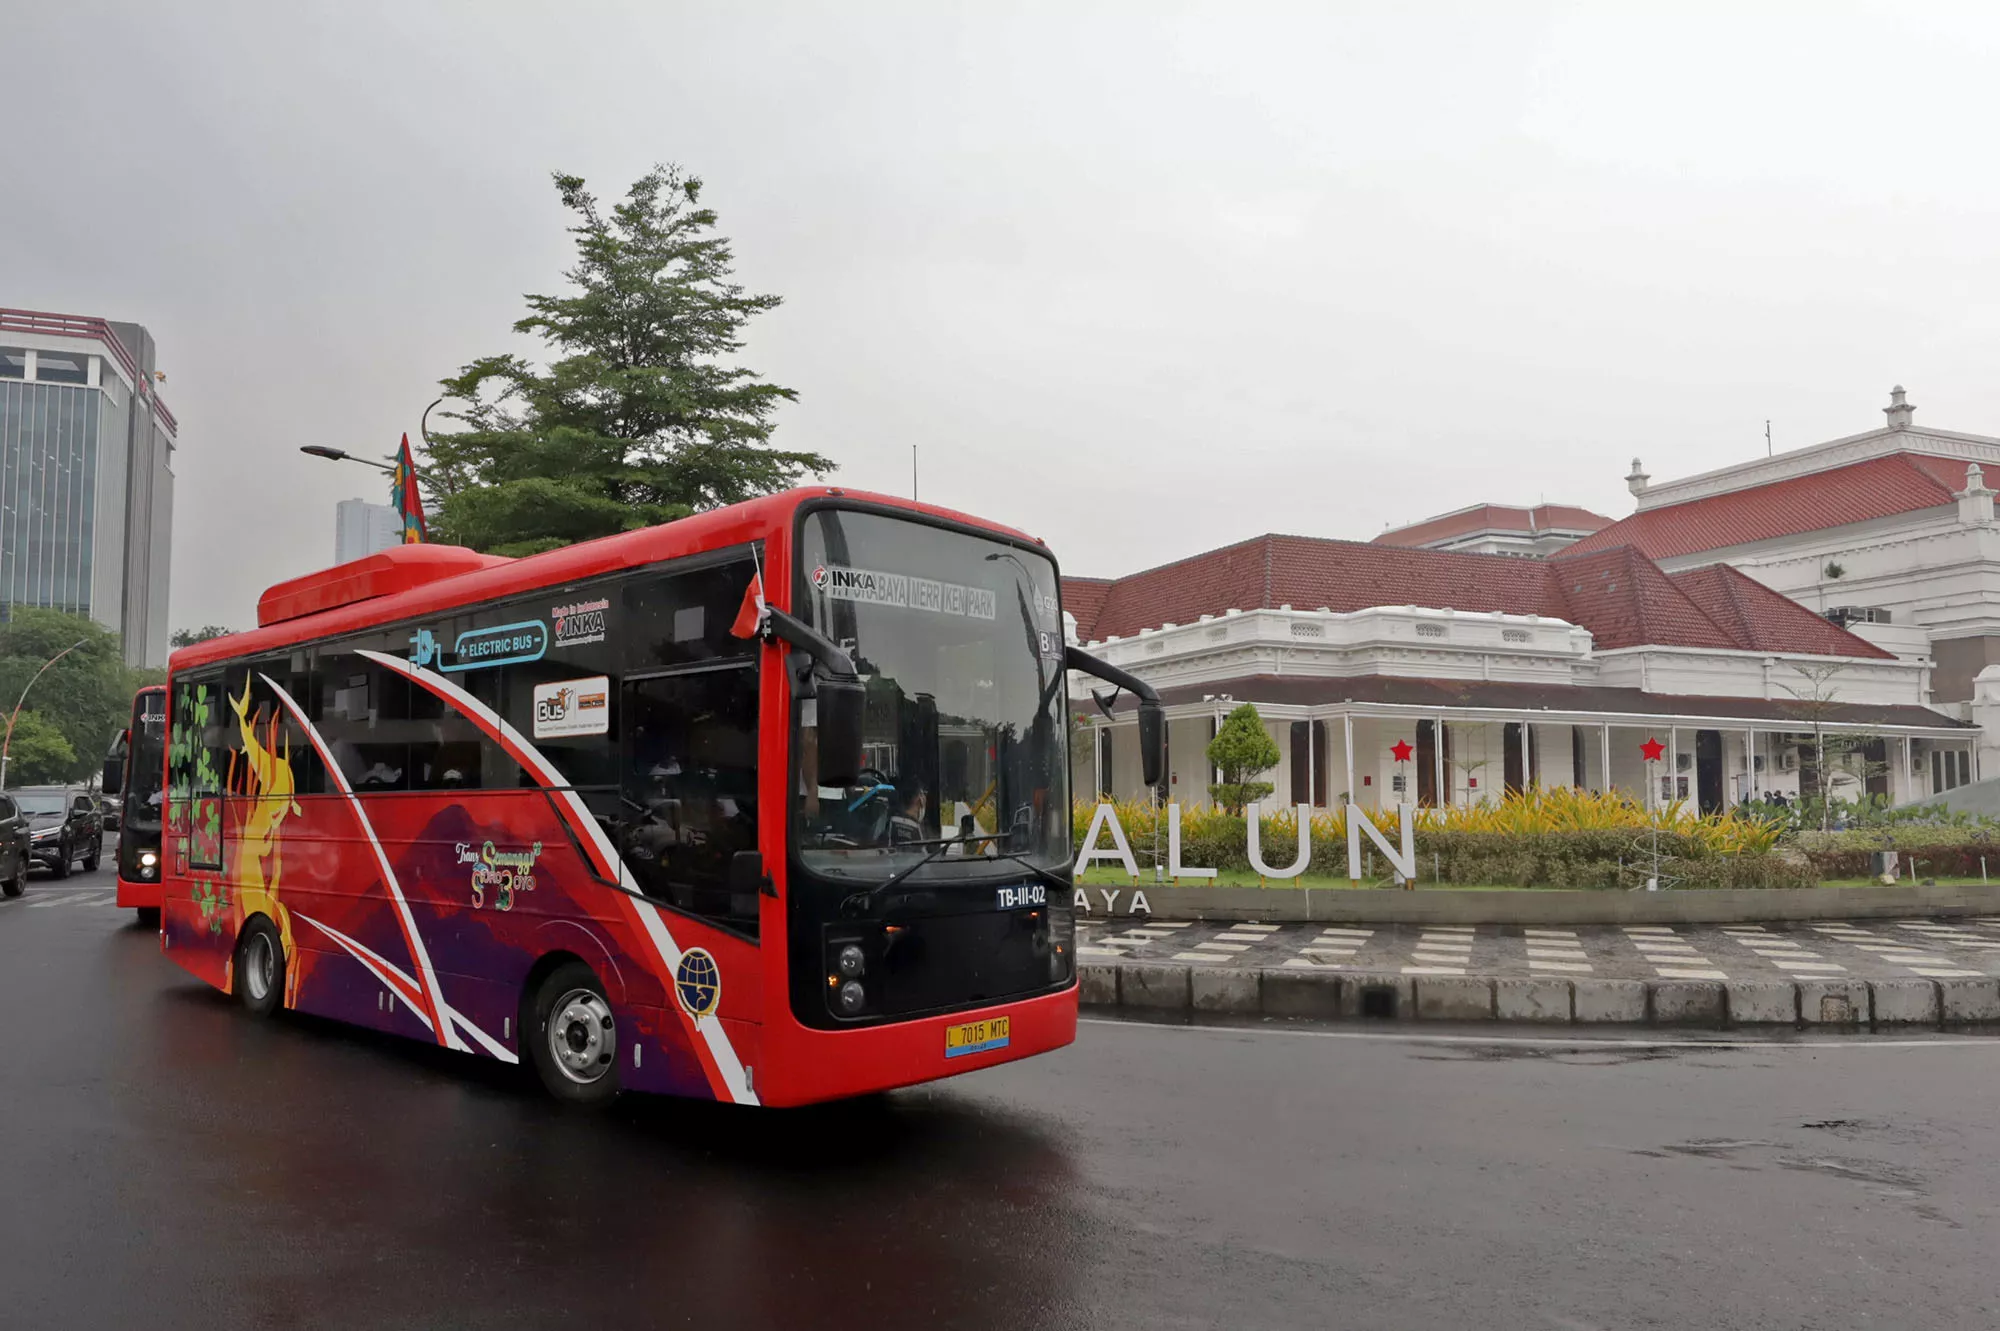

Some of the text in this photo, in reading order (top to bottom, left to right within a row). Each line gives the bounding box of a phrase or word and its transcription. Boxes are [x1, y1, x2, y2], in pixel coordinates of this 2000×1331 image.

[832, 570, 876, 591] INKA
[911, 579, 941, 609] MERR
[968, 589, 994, 618] PARK
[566, 611, 606, 637] INKA
[469, 634, 532, 657] ELECTRIC BUS
[148, 713, 166, 722] INK
[455, 842, 480, 864] Trans
[1074, 803, 1416, 880] ALUN
[998, 886, 1046, 908] TB-III-02
[962, 1024, 984, 1045] 7015
[991, 1019, 1008, 1039] MTC
